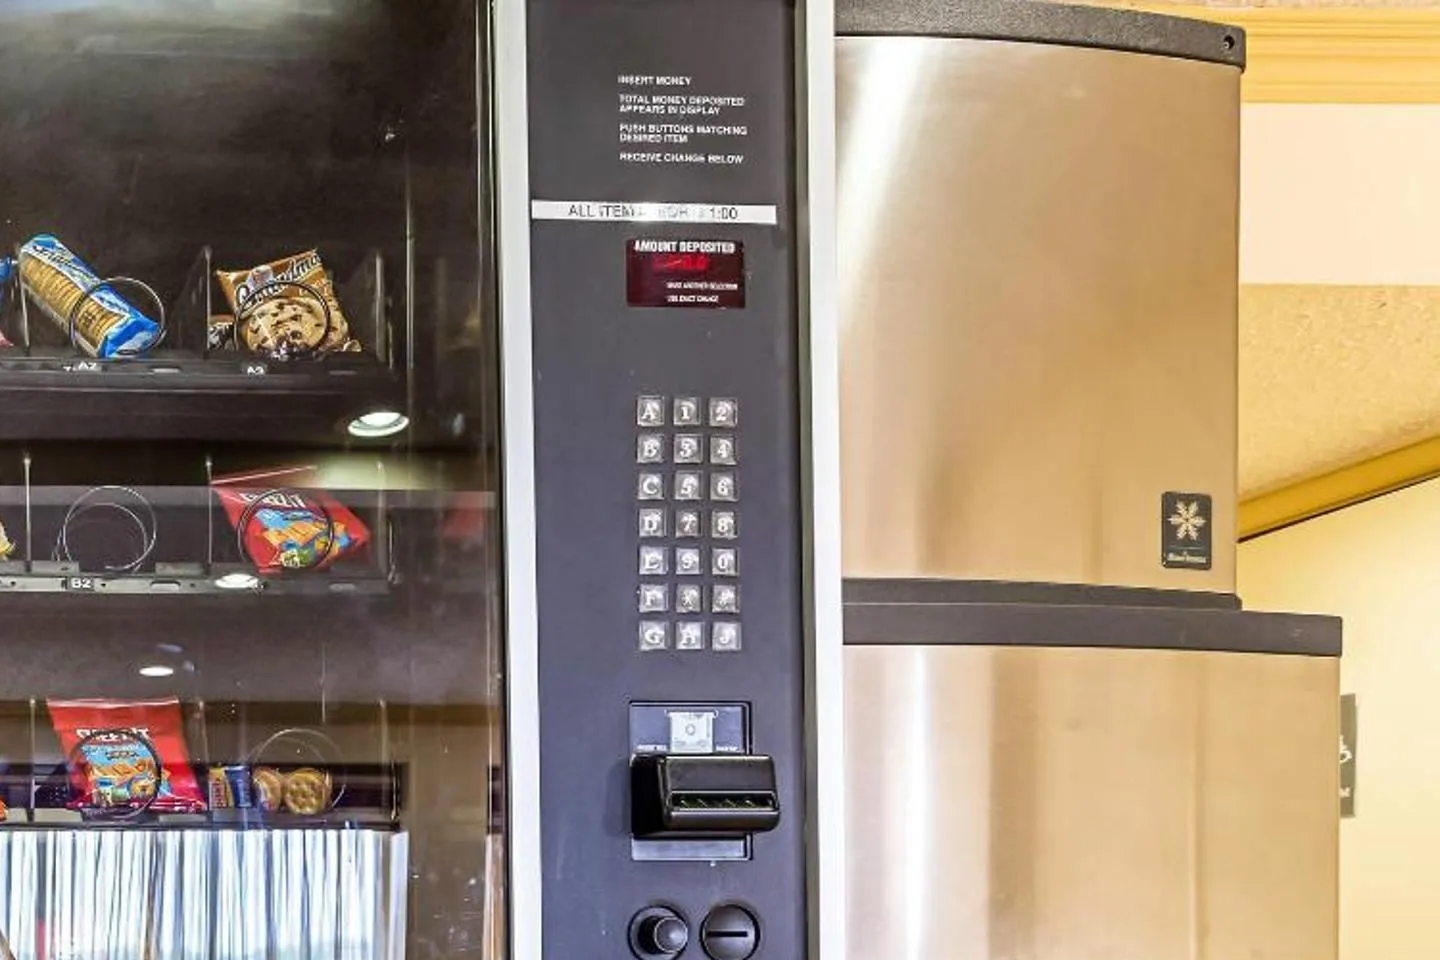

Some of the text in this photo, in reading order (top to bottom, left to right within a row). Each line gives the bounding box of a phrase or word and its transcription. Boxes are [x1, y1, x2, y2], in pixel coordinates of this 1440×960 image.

[618, 75, 692, 85] INSERT MONEY
[619, 94, 745, 106] TOTAL MONEY DEPOSITED
[619, 105, 720, 115] APPEARS IN DISPLAY
[619, 124, 748, 135] PUSH BUTTONS MATCHING
[619, 134, 688, 143] DESIRED ITEM
[619, 153, 744, 164] RECEIVE CHANGE BELOW
[568, 205, 595, 218] ALL
[635, 240, 736, 254] AMOUNT DEPOSITED
[642, 402, 656, 420] A
[715, 405, 729, 421] 2
[642, 477, 658, 495] C
[71, 578, 92, 589] B2
